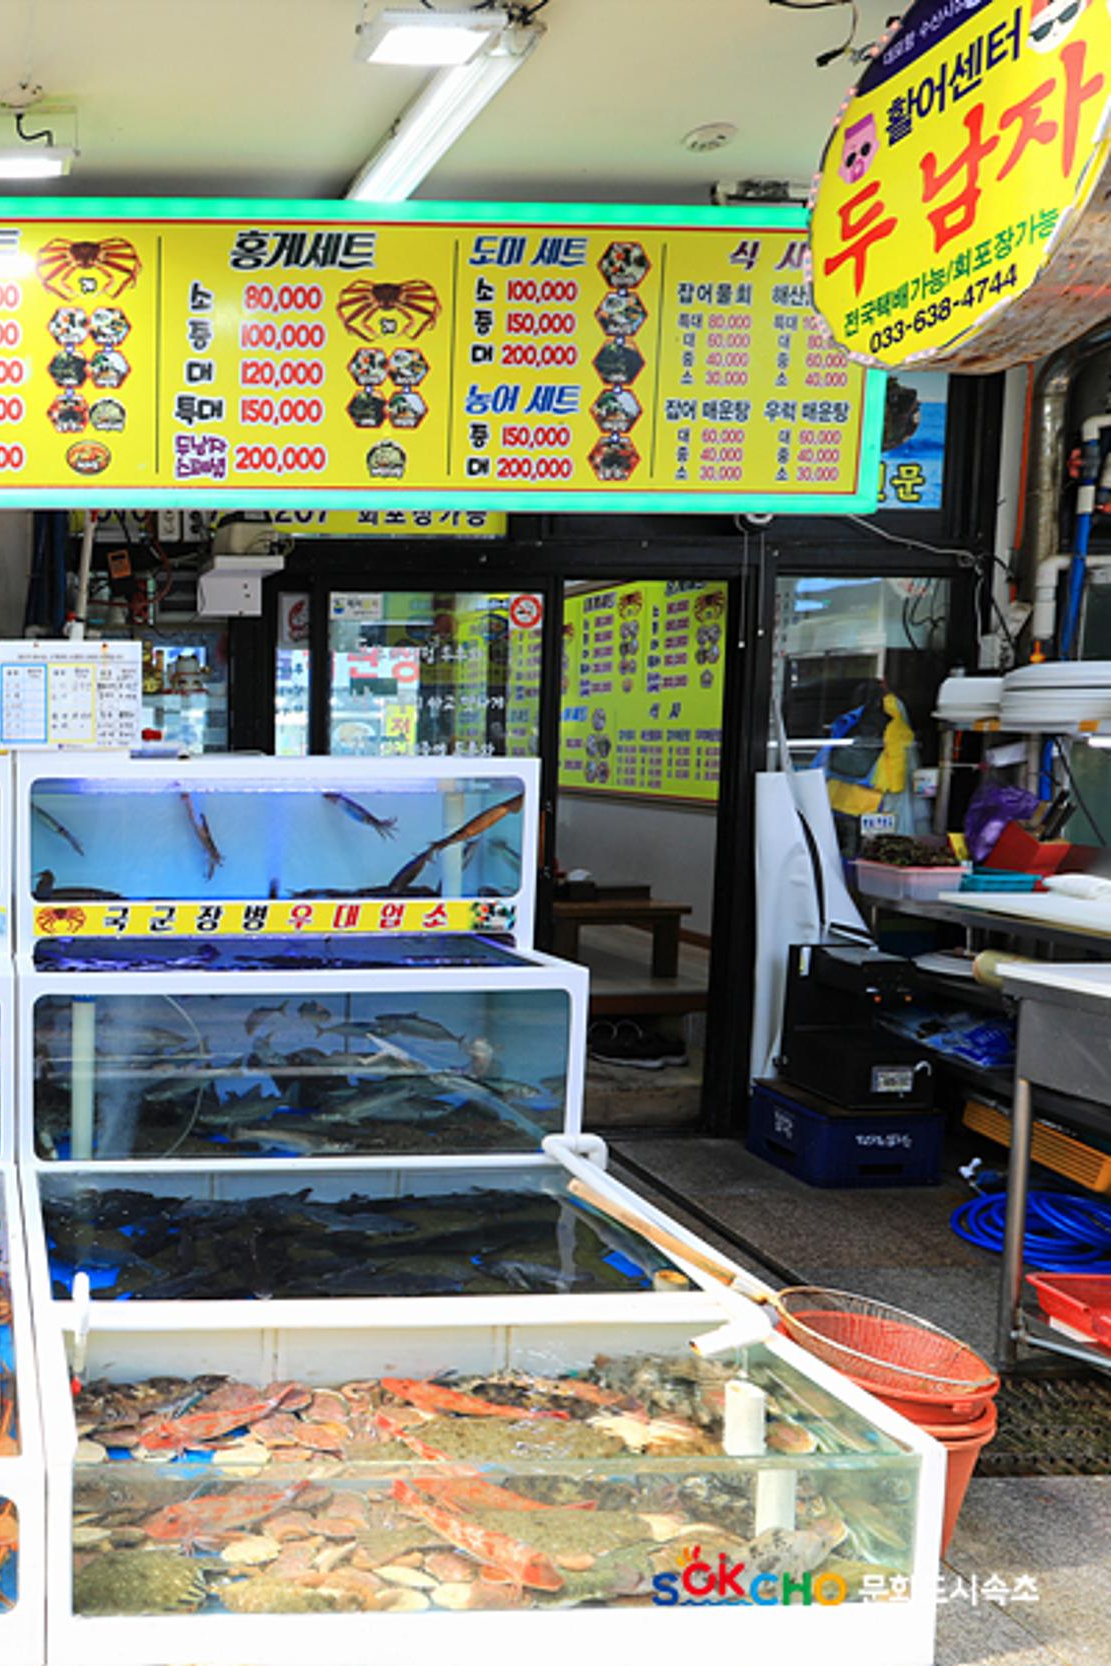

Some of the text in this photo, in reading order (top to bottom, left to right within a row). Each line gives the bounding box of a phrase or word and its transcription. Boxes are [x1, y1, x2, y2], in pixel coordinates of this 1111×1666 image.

[886, 7, 1021, 147] 활어센터
[824, 40, 1105, 298] 두 남자
[230, 230, 376, 270] 홍게세트
[469, 237, 587, 267] 도미 세트
[845, 208, 1059, 338] 전국택배가능/회포장가능
[191, 282, 322, 312] 소 80,000
[476, 278, 577, 304] 소 100,000
[772, 284, 811, 306] 해산
[474, 310, 575, 337] 중 150,000
[870, 264, 1018, 353] 033-638-4744
[189, 320, 325, 351] 중 100,000
[471, 344, 577, 368] 대 200,000
[186, 361, 324, 388] 대 120,000
[175, 395, 323, 425] 특대 150,000
[466, 384, 580, 415] 농어 세트
[470, 424, 570, 450] 중 150,000
[235, 446, 326, 472] 200,000
[467, 457, 572, 481] 대 200,000
